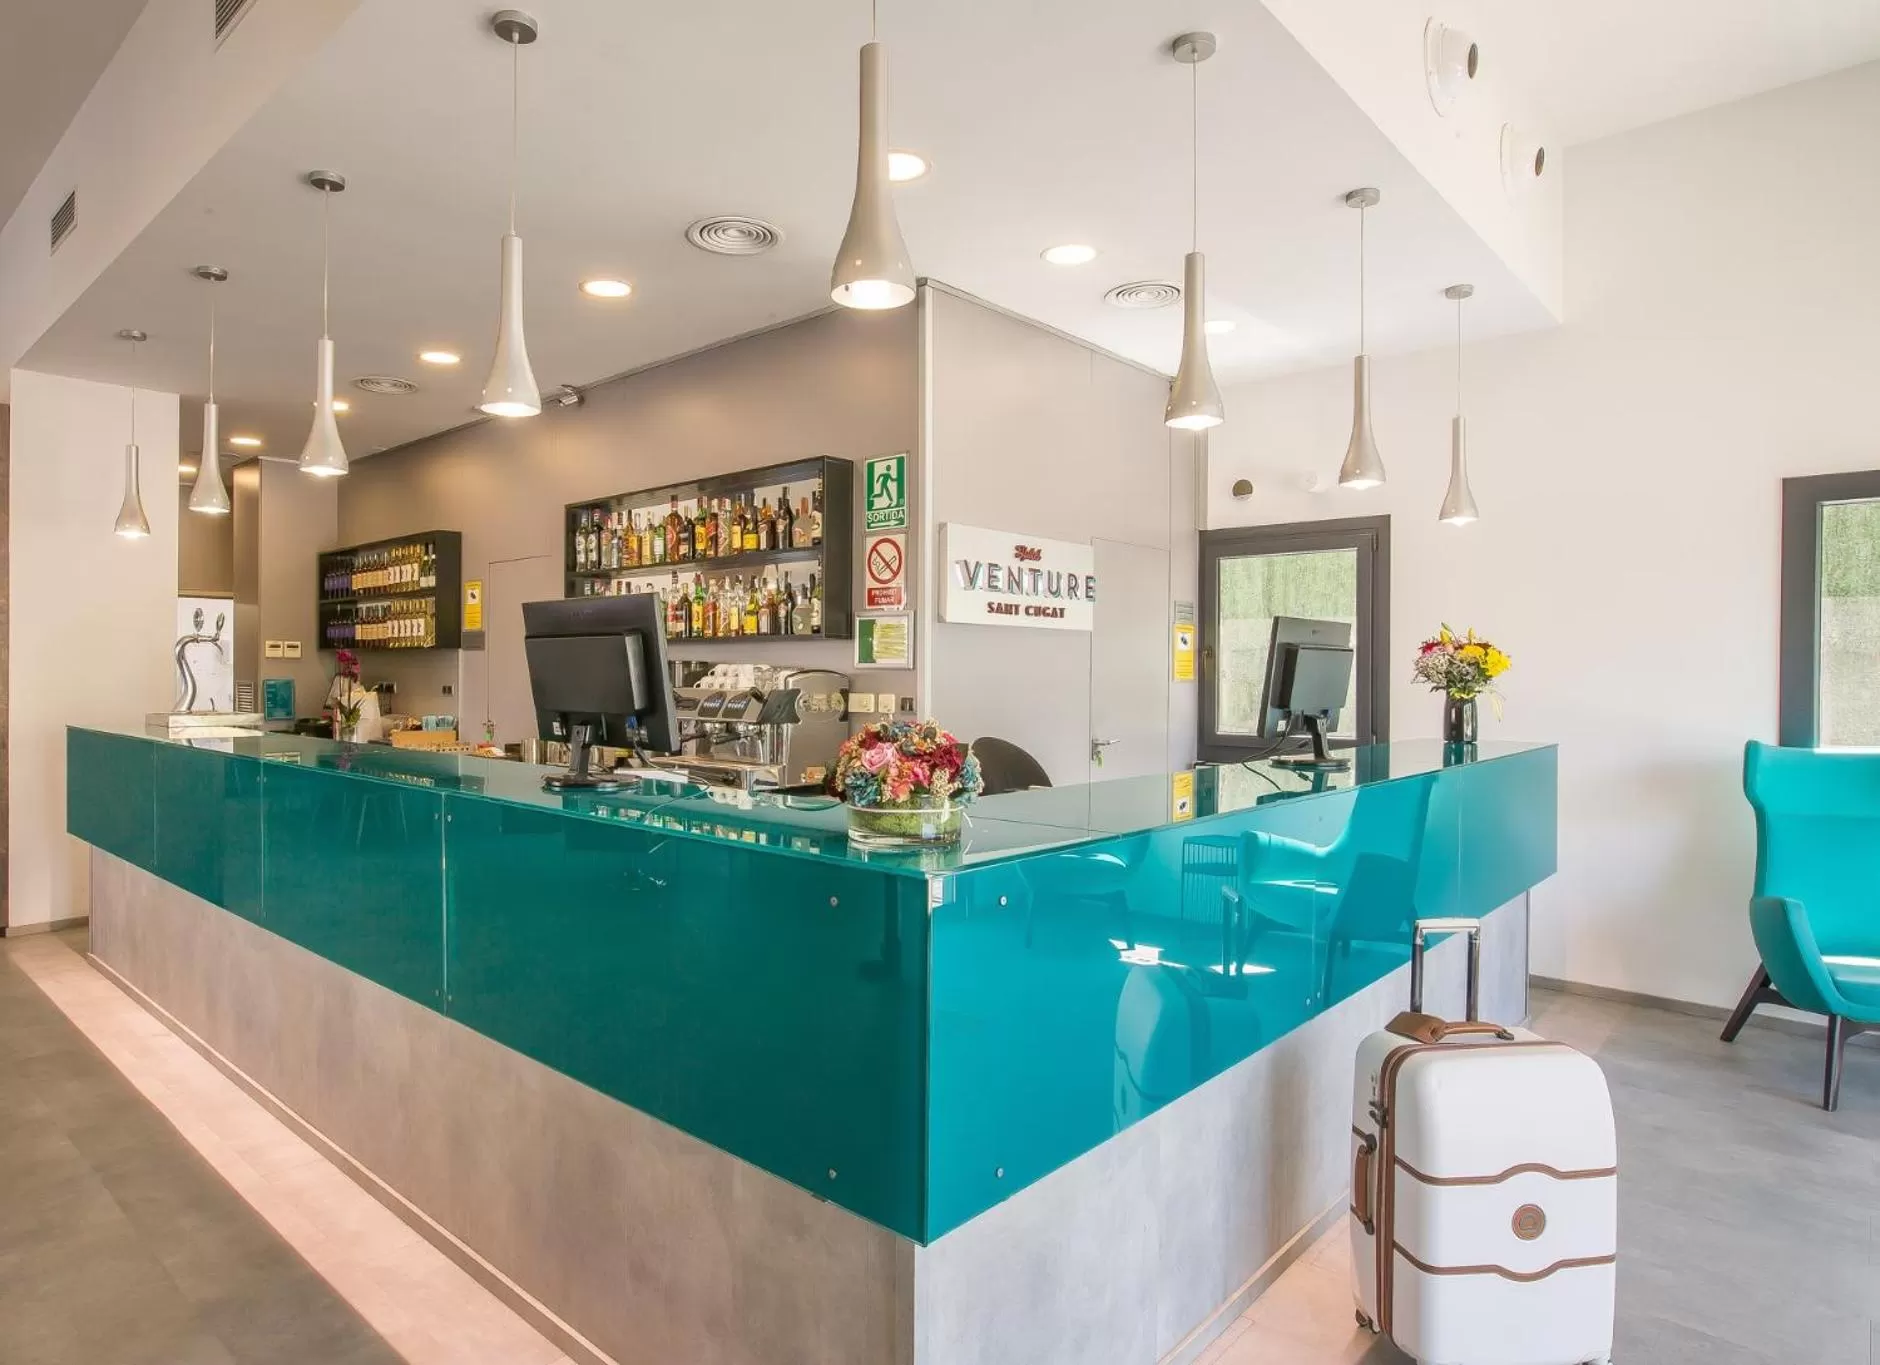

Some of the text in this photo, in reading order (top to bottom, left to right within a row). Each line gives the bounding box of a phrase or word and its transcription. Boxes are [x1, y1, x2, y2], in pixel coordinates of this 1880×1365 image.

[866, 509, 905, 524] SORTIDA
[956, 559, 1096, 602] VENTURE
[987, 601, 1066, 619] SANT CUGAT
